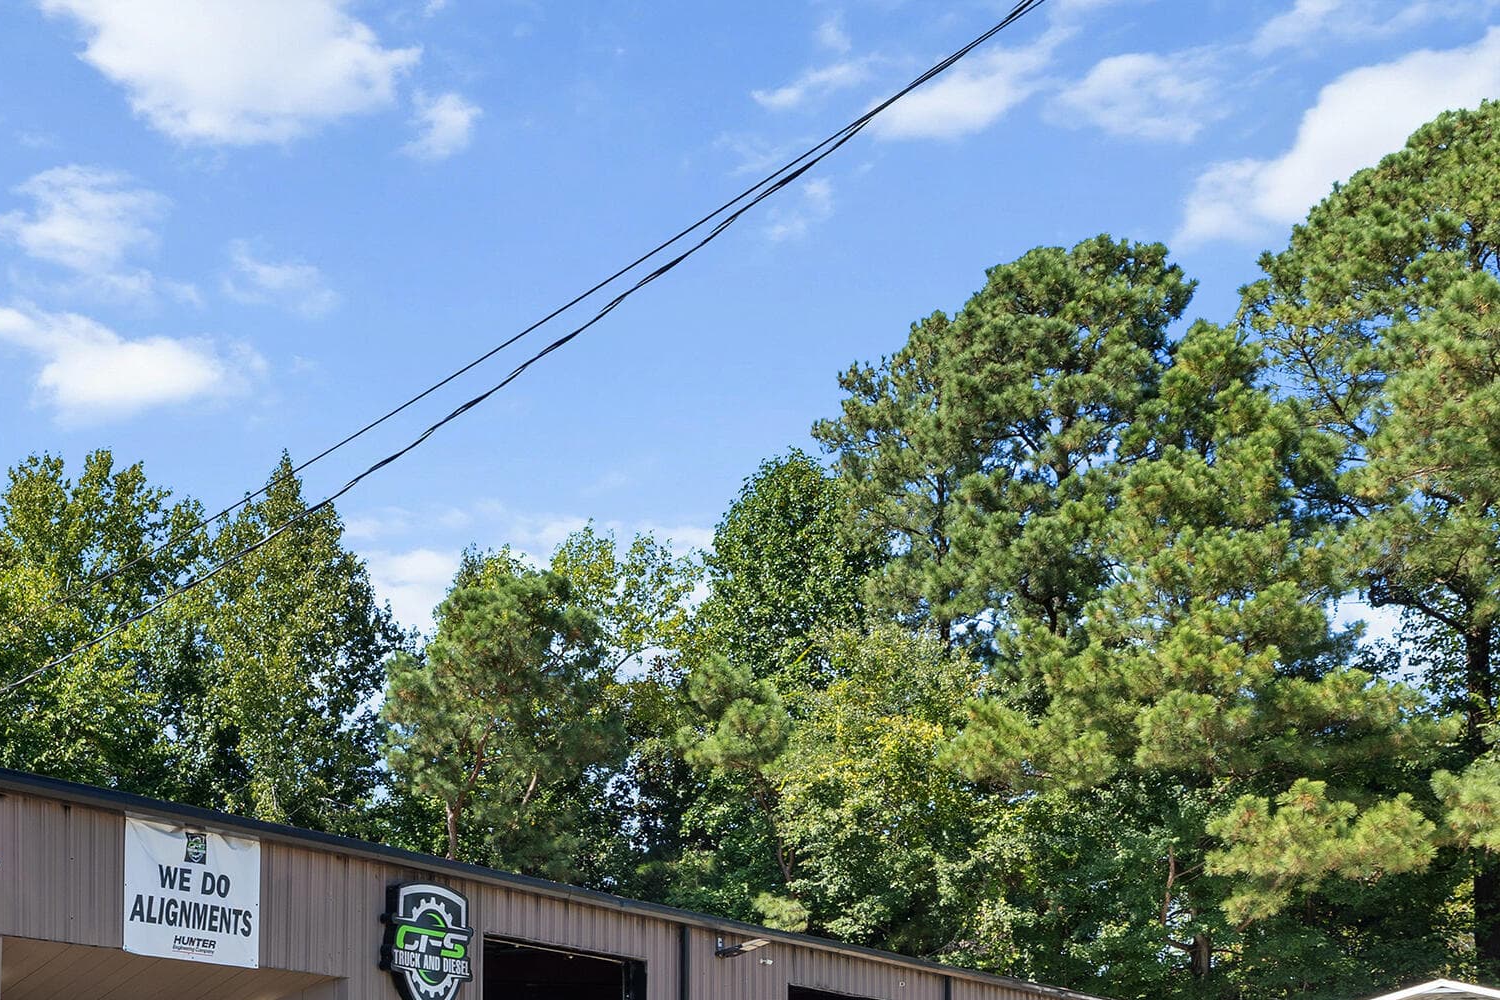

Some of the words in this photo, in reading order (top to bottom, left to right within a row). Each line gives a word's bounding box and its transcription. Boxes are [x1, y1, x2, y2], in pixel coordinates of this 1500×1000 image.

[158, 864, 192, 892] WE
[201, 871, 230, 898] DO
[129, 894, 253, 938] ALIGNMENTS
[173, 935, 216, 949] HUNTER
[394, 949, 421, 968] TRUCK
[423, 954, 441, 971] AND
[443, 957, 470, 976] DIESEL
